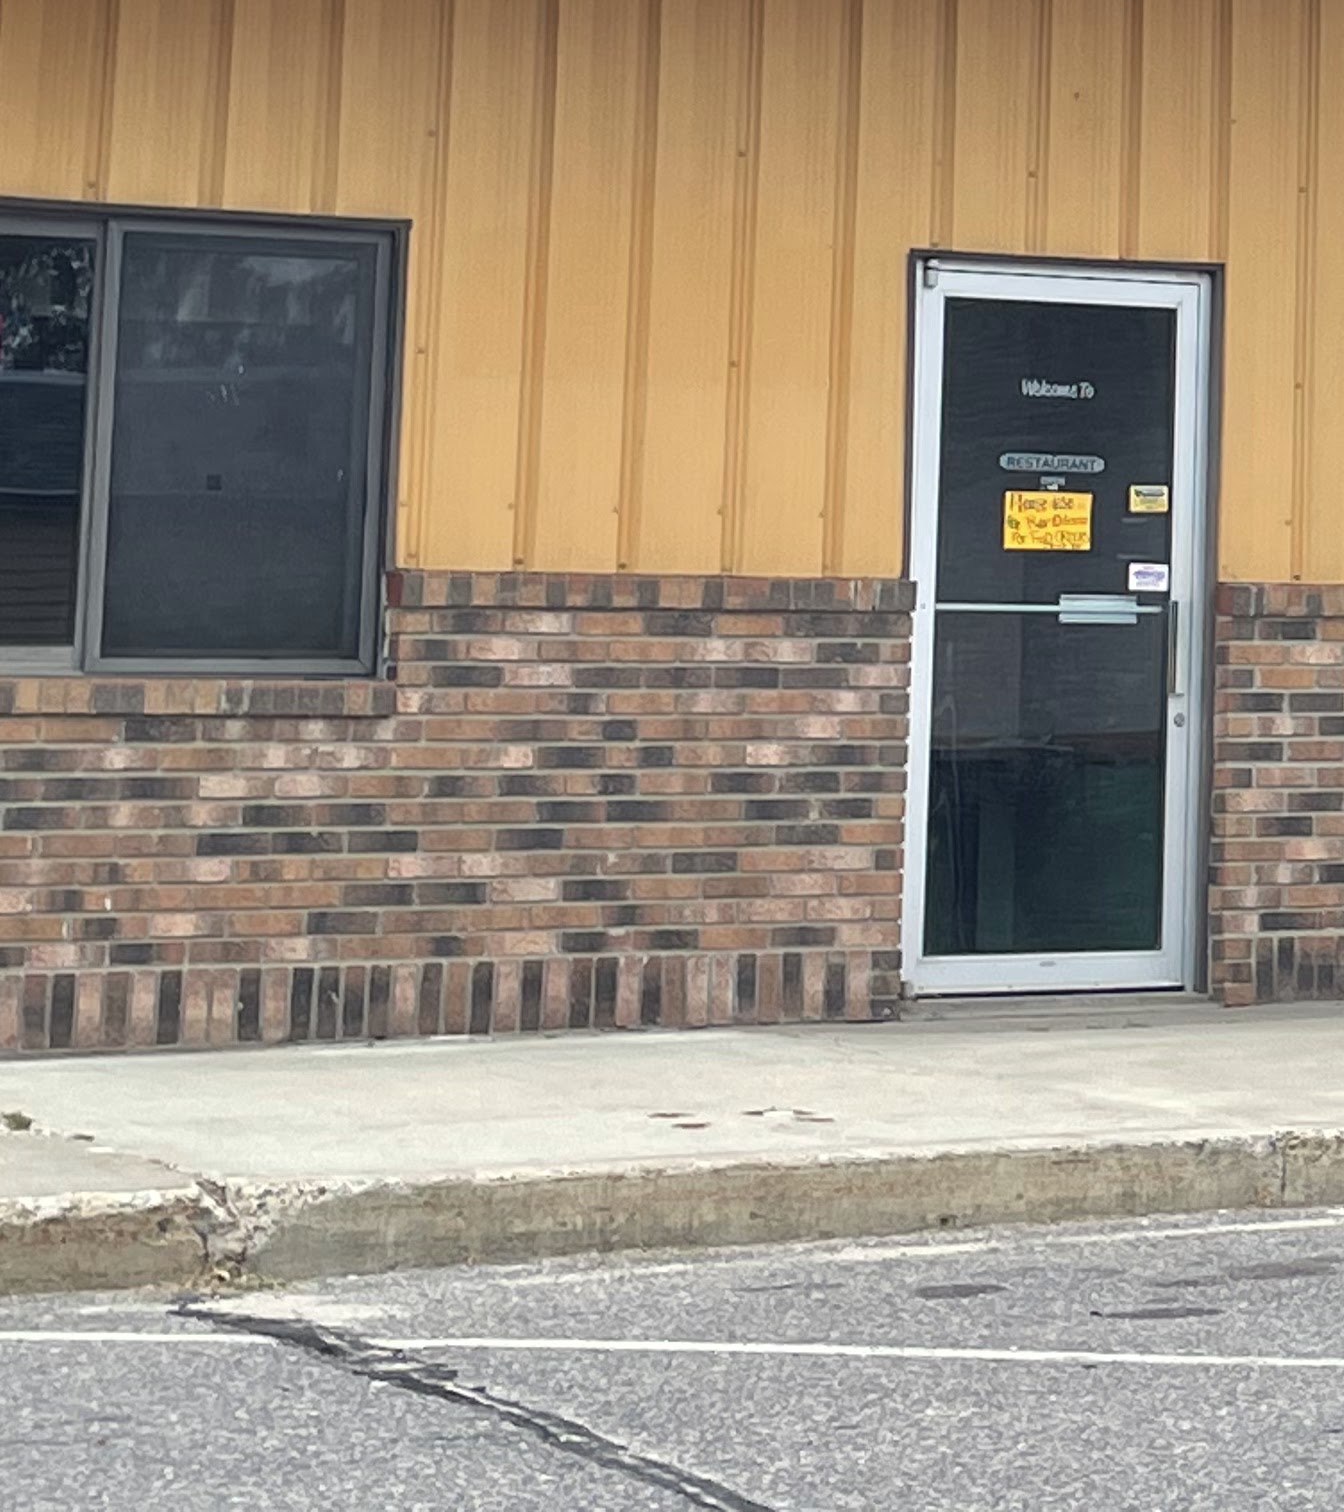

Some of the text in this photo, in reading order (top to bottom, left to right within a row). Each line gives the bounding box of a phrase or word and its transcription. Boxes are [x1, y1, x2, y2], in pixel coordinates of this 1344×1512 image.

[1021, 378, 1095, 399] Welcome To
[1007, 456, 1096, 471] RESTAURANT
